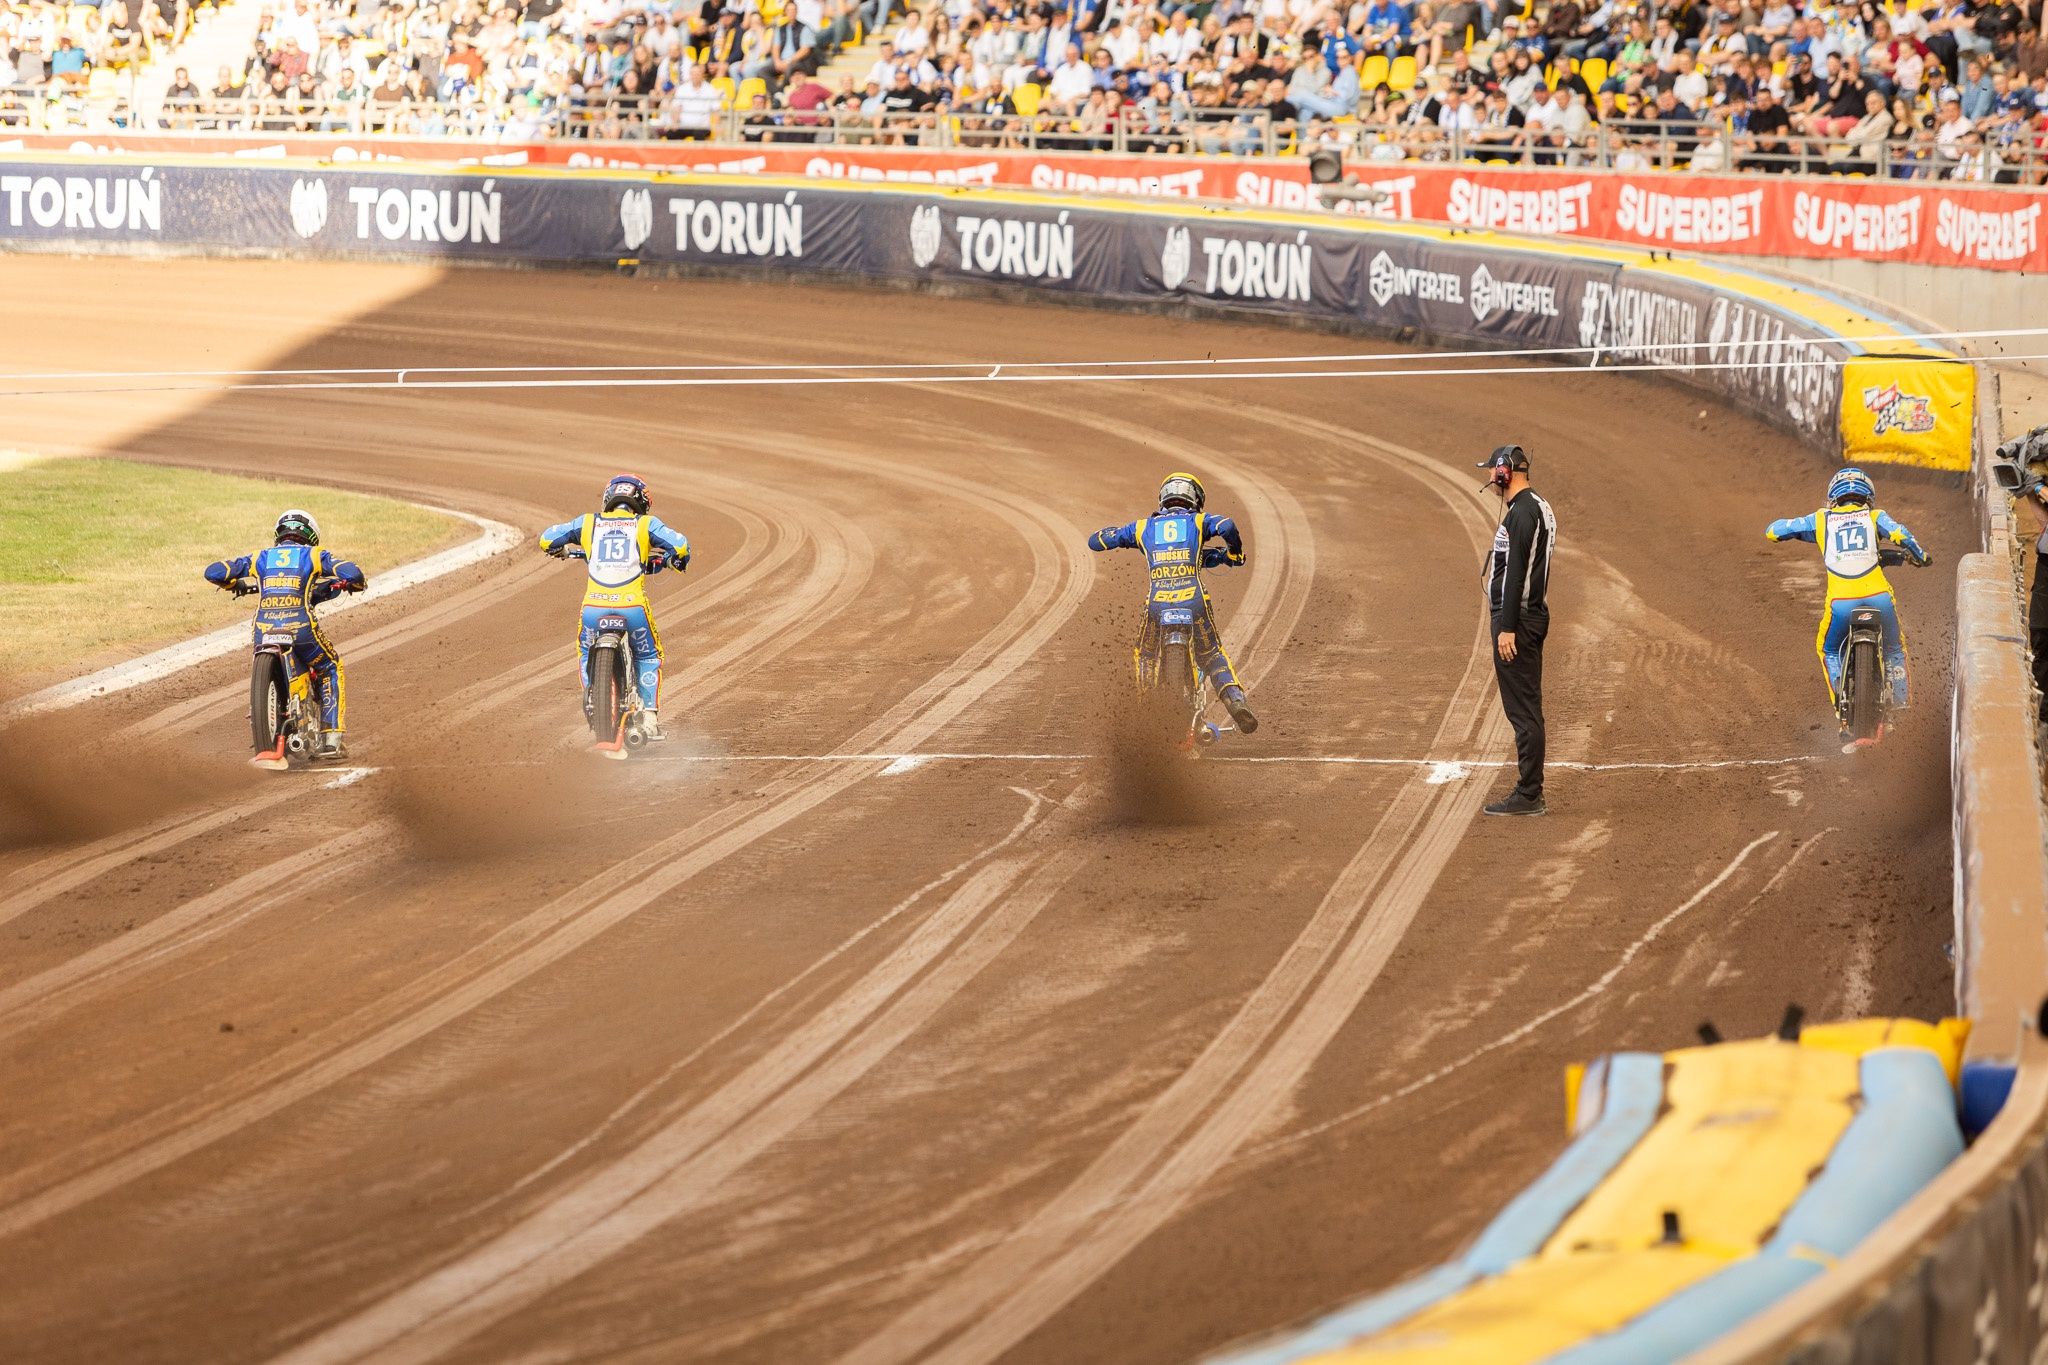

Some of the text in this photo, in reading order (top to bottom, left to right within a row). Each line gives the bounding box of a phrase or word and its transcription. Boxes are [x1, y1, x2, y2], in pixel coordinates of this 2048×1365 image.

[1, 166, 161, 231] TORUŃ
[348, 178, 502, 244] TORUŃ
[668, 190, 803, 257] TORUŃ
[1446, 178, 1593, 234] SUPERBET
[1615, 183, 1764, 244] SUPERBET
[1792, 190, 1922, 252] SUPERBET
[956, 210, 1075, 280] TORUŃ
[1935, 198, 2042, 261] SUPERBET
[1202, 230, 1312, 302] TORUŃ
[275, 549, 291, 567] 3
[603, 538, 625, 560] 13
[1163, 520, 1178, 542] 6
[1838, 528, 1864, 550] 14
[261, 594, 302, 608] GORZÓW
[1151, 563, 1196, 579] GORZÓW
